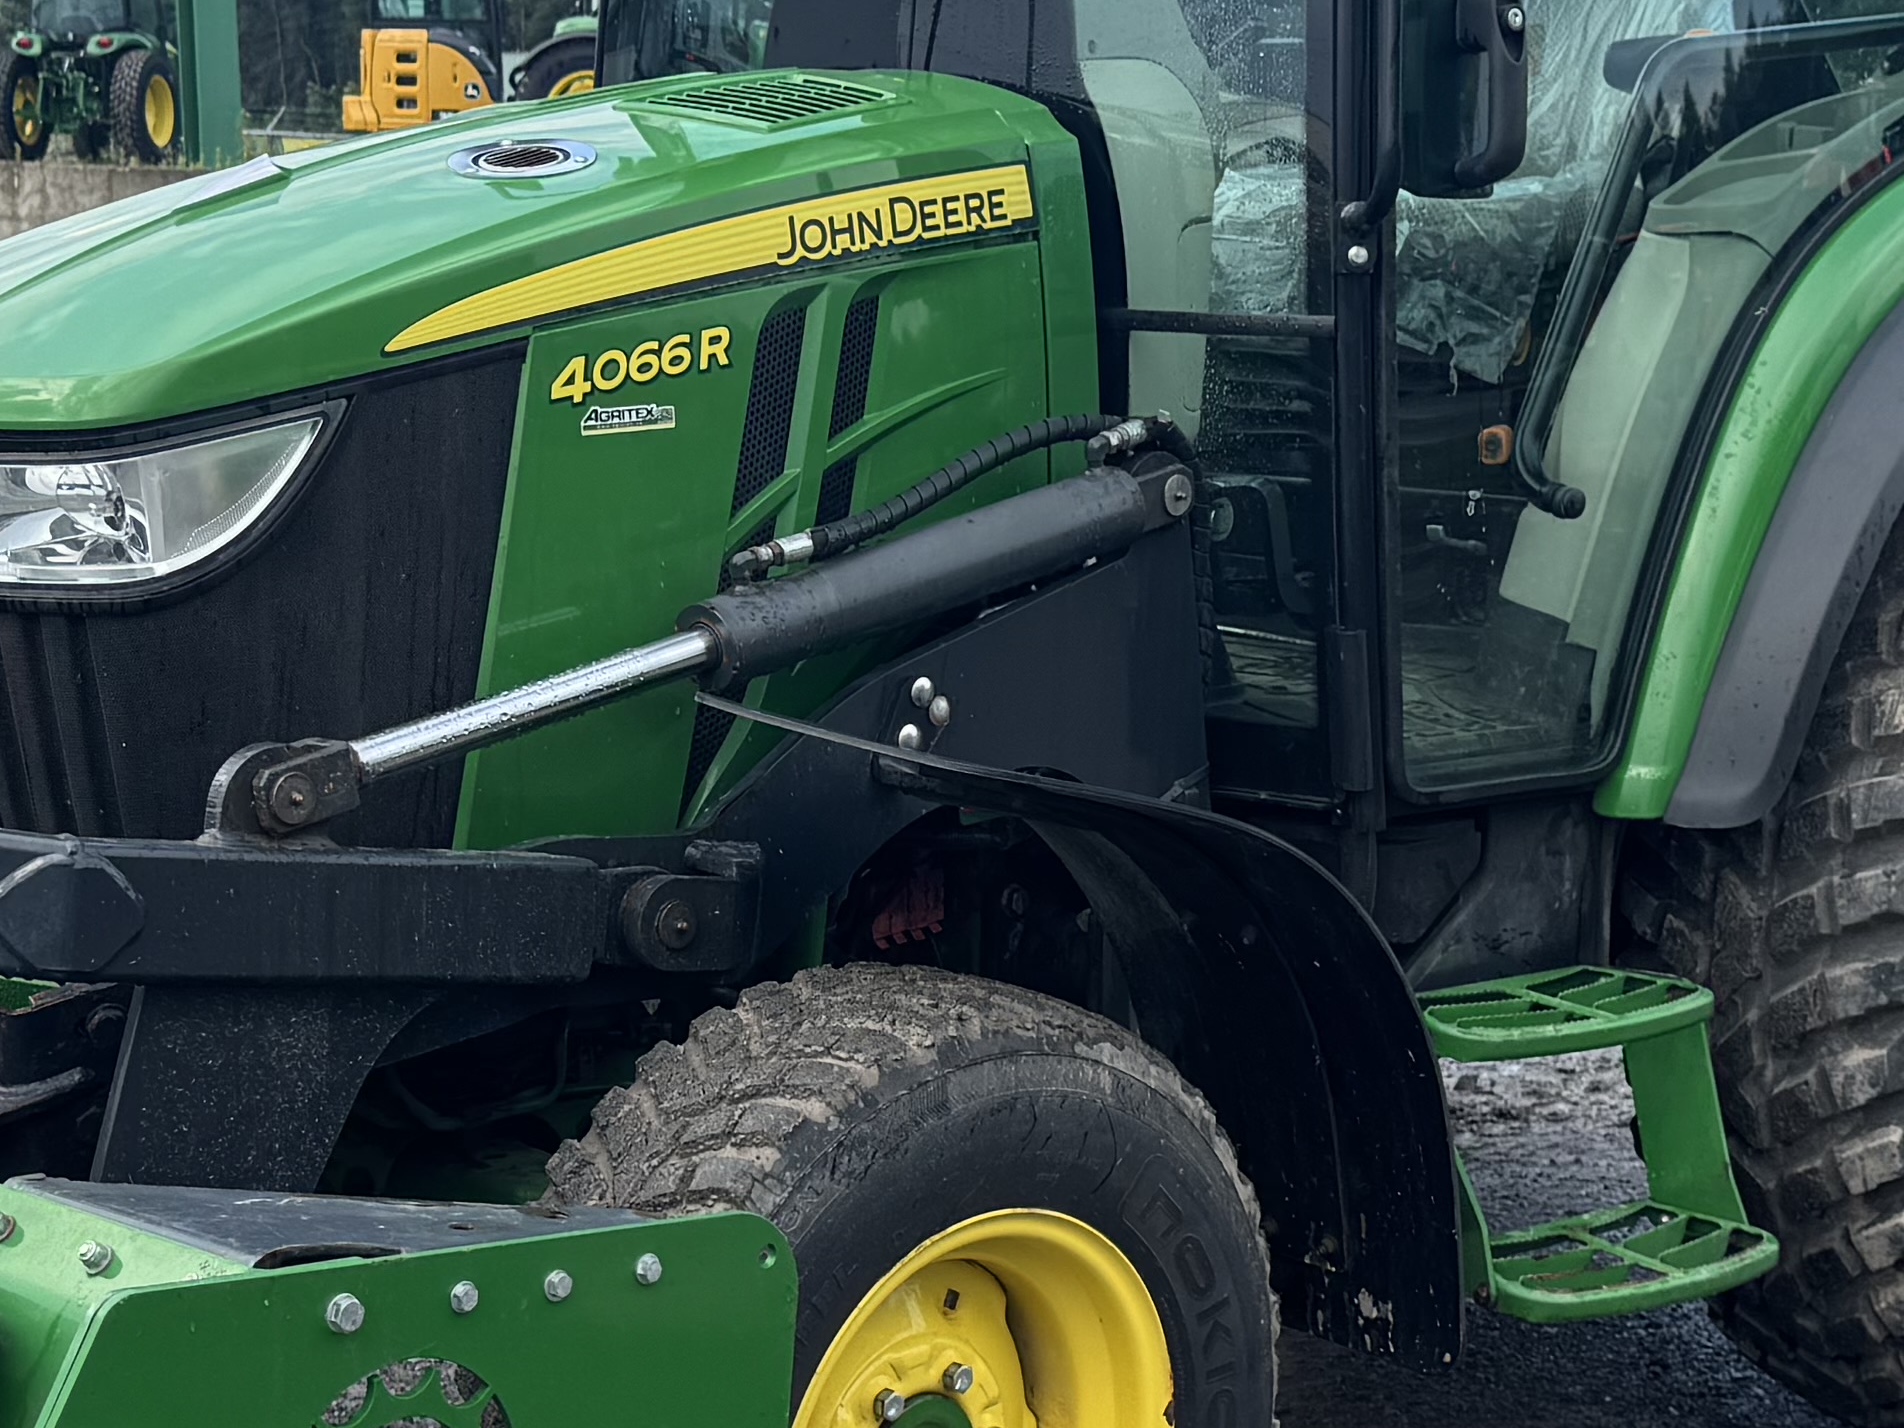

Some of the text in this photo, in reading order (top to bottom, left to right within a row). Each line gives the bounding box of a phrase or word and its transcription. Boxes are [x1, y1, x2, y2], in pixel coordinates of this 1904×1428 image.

[776, 188, 1008, 260] JOHN DEERE
[583, 406, 656, 424] AGRITEX
